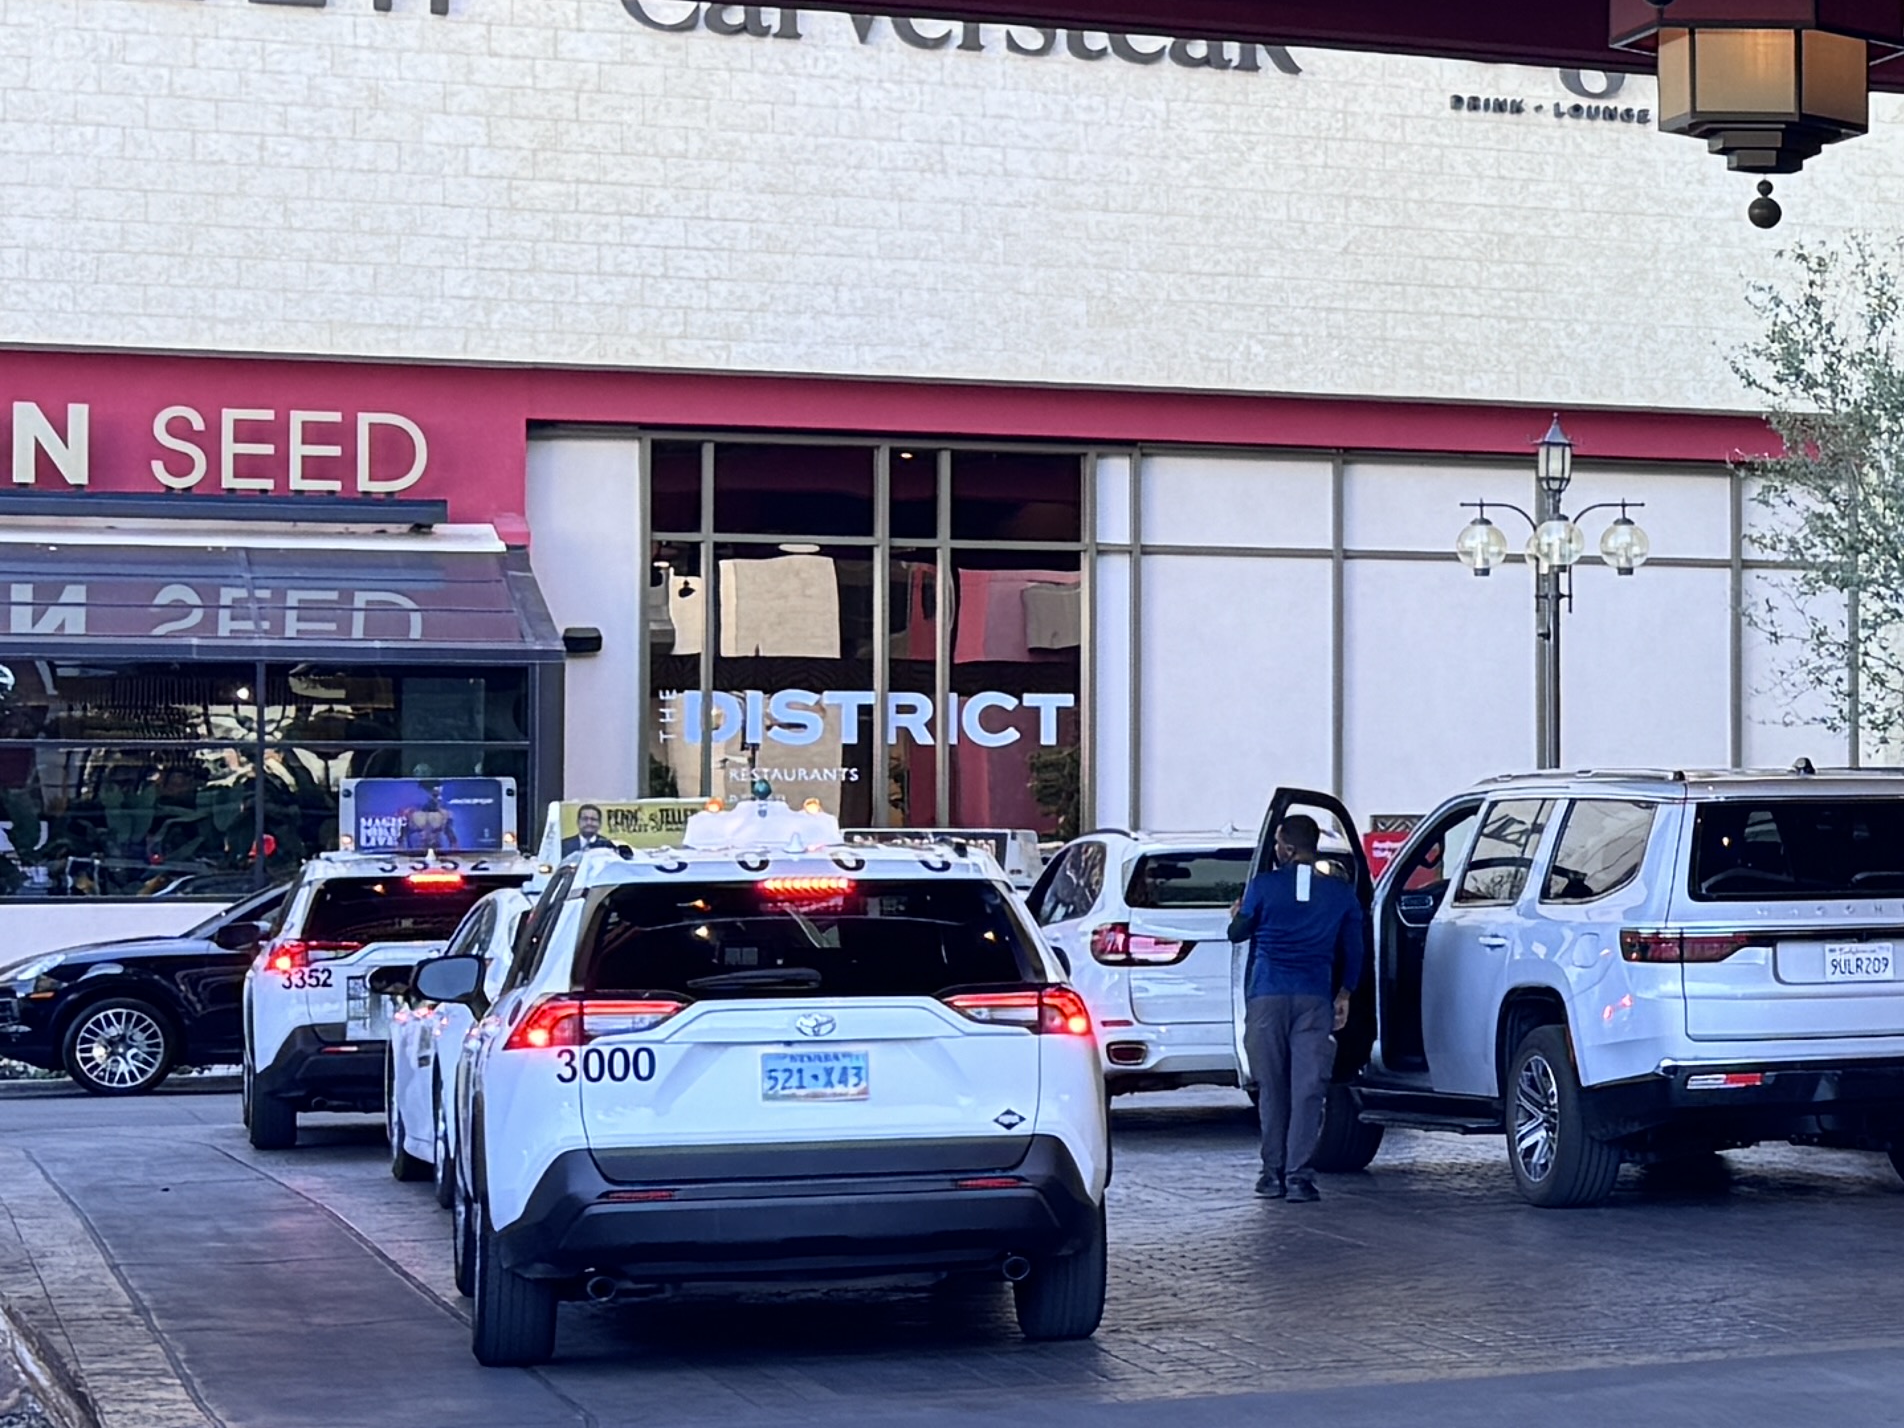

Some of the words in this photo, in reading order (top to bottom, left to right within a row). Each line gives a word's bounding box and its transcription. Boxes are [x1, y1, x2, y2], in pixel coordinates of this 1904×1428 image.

[1553, 102, 1651, 125] LOUNGE
[11, 402, 90, 486] N
[150, 405, 428, 493] SEED
[659, 689, 677, 743] THE
[683, 688, 1074, 748] DISTRICT
[729, 767, 859, 783] RESTAURANTS
[281, 967, 333, 990] 3352
[556, 1047, 657, 1084] 3000
